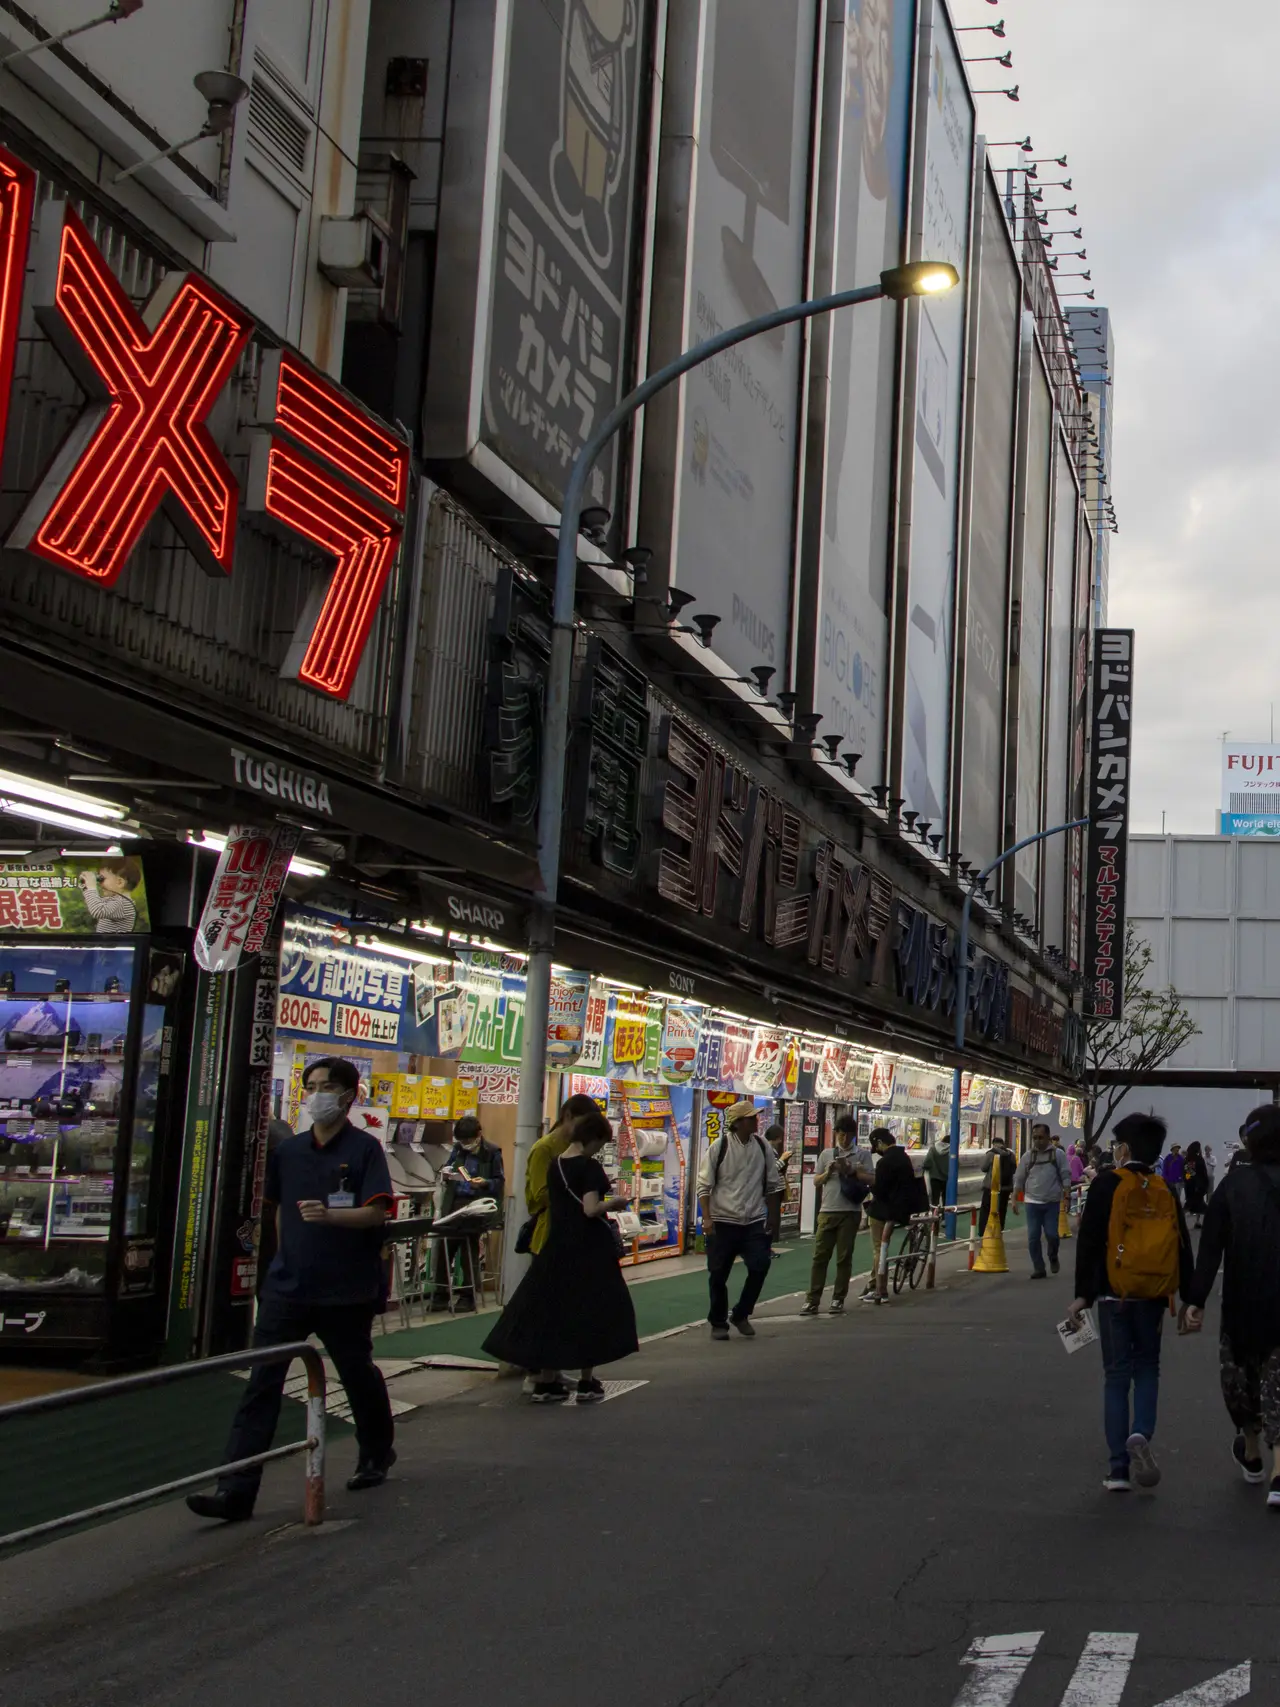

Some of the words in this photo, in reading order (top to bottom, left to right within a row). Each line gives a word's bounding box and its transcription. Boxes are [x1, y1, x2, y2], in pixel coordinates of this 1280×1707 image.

[504, 208, 612, 384] ヨドバシ
[517, 312, 597, 442] カメラ
[733, 593, 775, 663] PHILIPS
[823, 612, 877, 719] BIGLOBE
[1096, 634, 1130, 841] ヨドバシカメラ
[1232, 818, 1264, 829] World
[657, 713, 893, 988] ヨドバシカメラ
[447, 895, 505, 931] SHARP
[1093, 845, 1120, 1016] マルチメディア北館
[548, 986, 576, 1001] Enjoy
[669, 972, 695, 994] SONY
[666, 1026, 697, 1039] Print!
[667, 1016, 689, 1030] Enjoy
[616, 1025, 645, 1059] 使える
[0, 1310, 47, 1333] ープ
